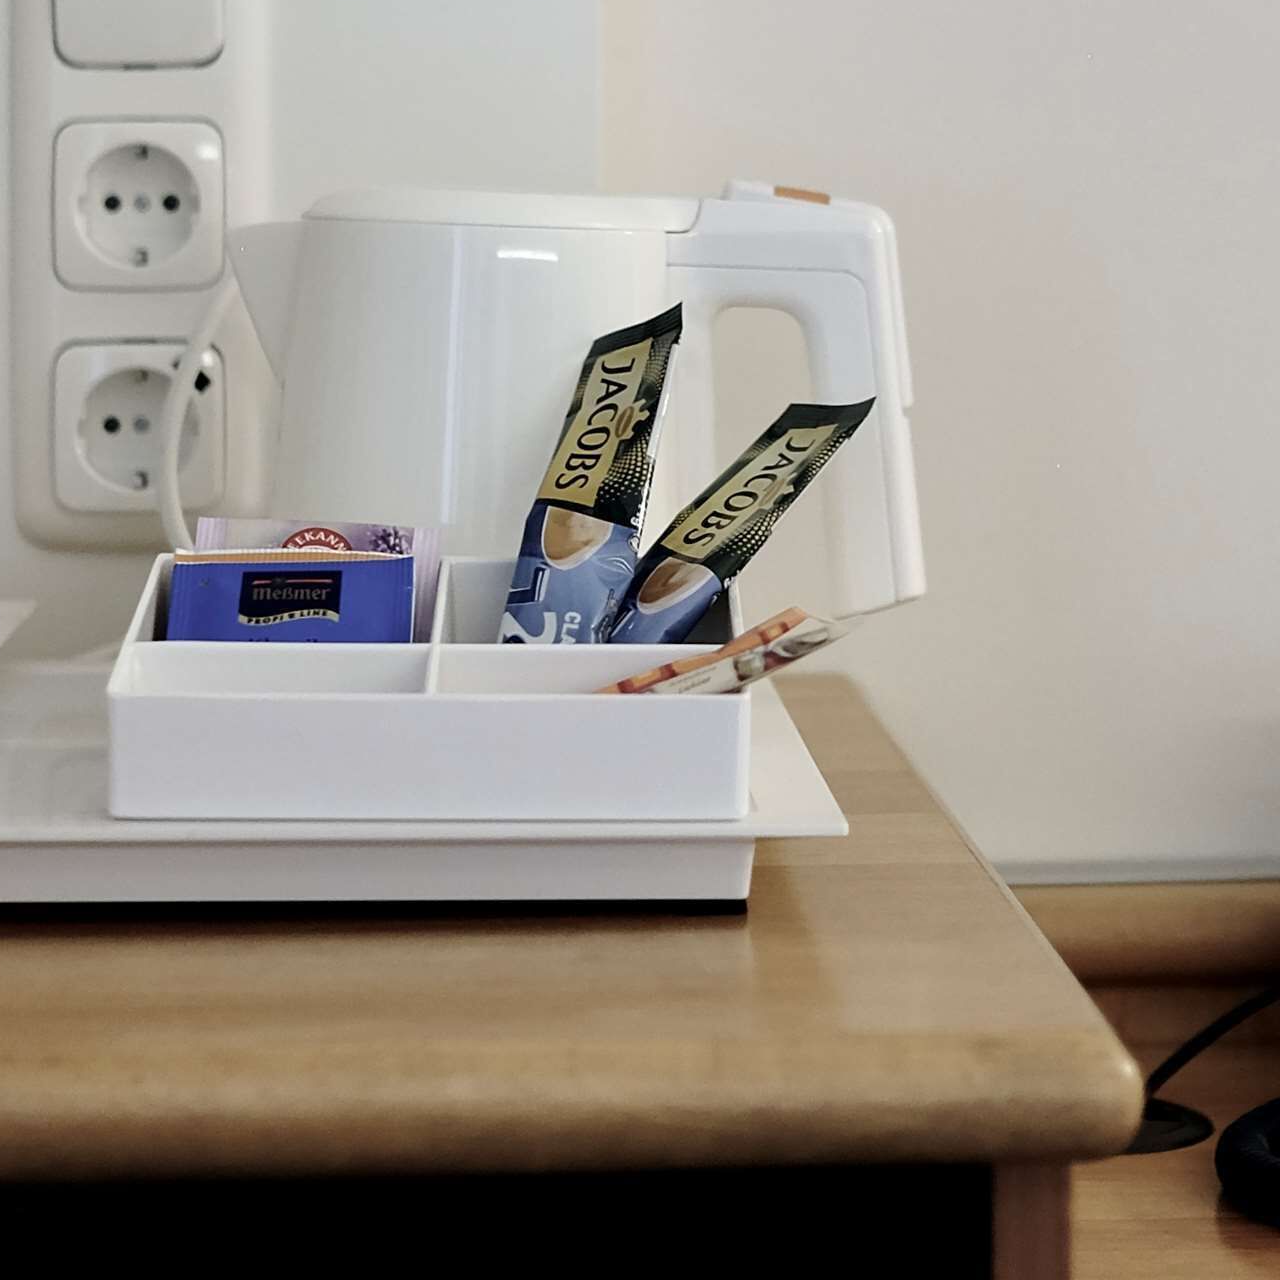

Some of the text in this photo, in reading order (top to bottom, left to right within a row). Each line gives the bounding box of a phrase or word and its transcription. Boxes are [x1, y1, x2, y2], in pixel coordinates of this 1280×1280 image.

[554, 357, 636, 490] JACOBS
[682, 436, 816, 547] JACOBS
[299, 608, 328, 618] LINE
